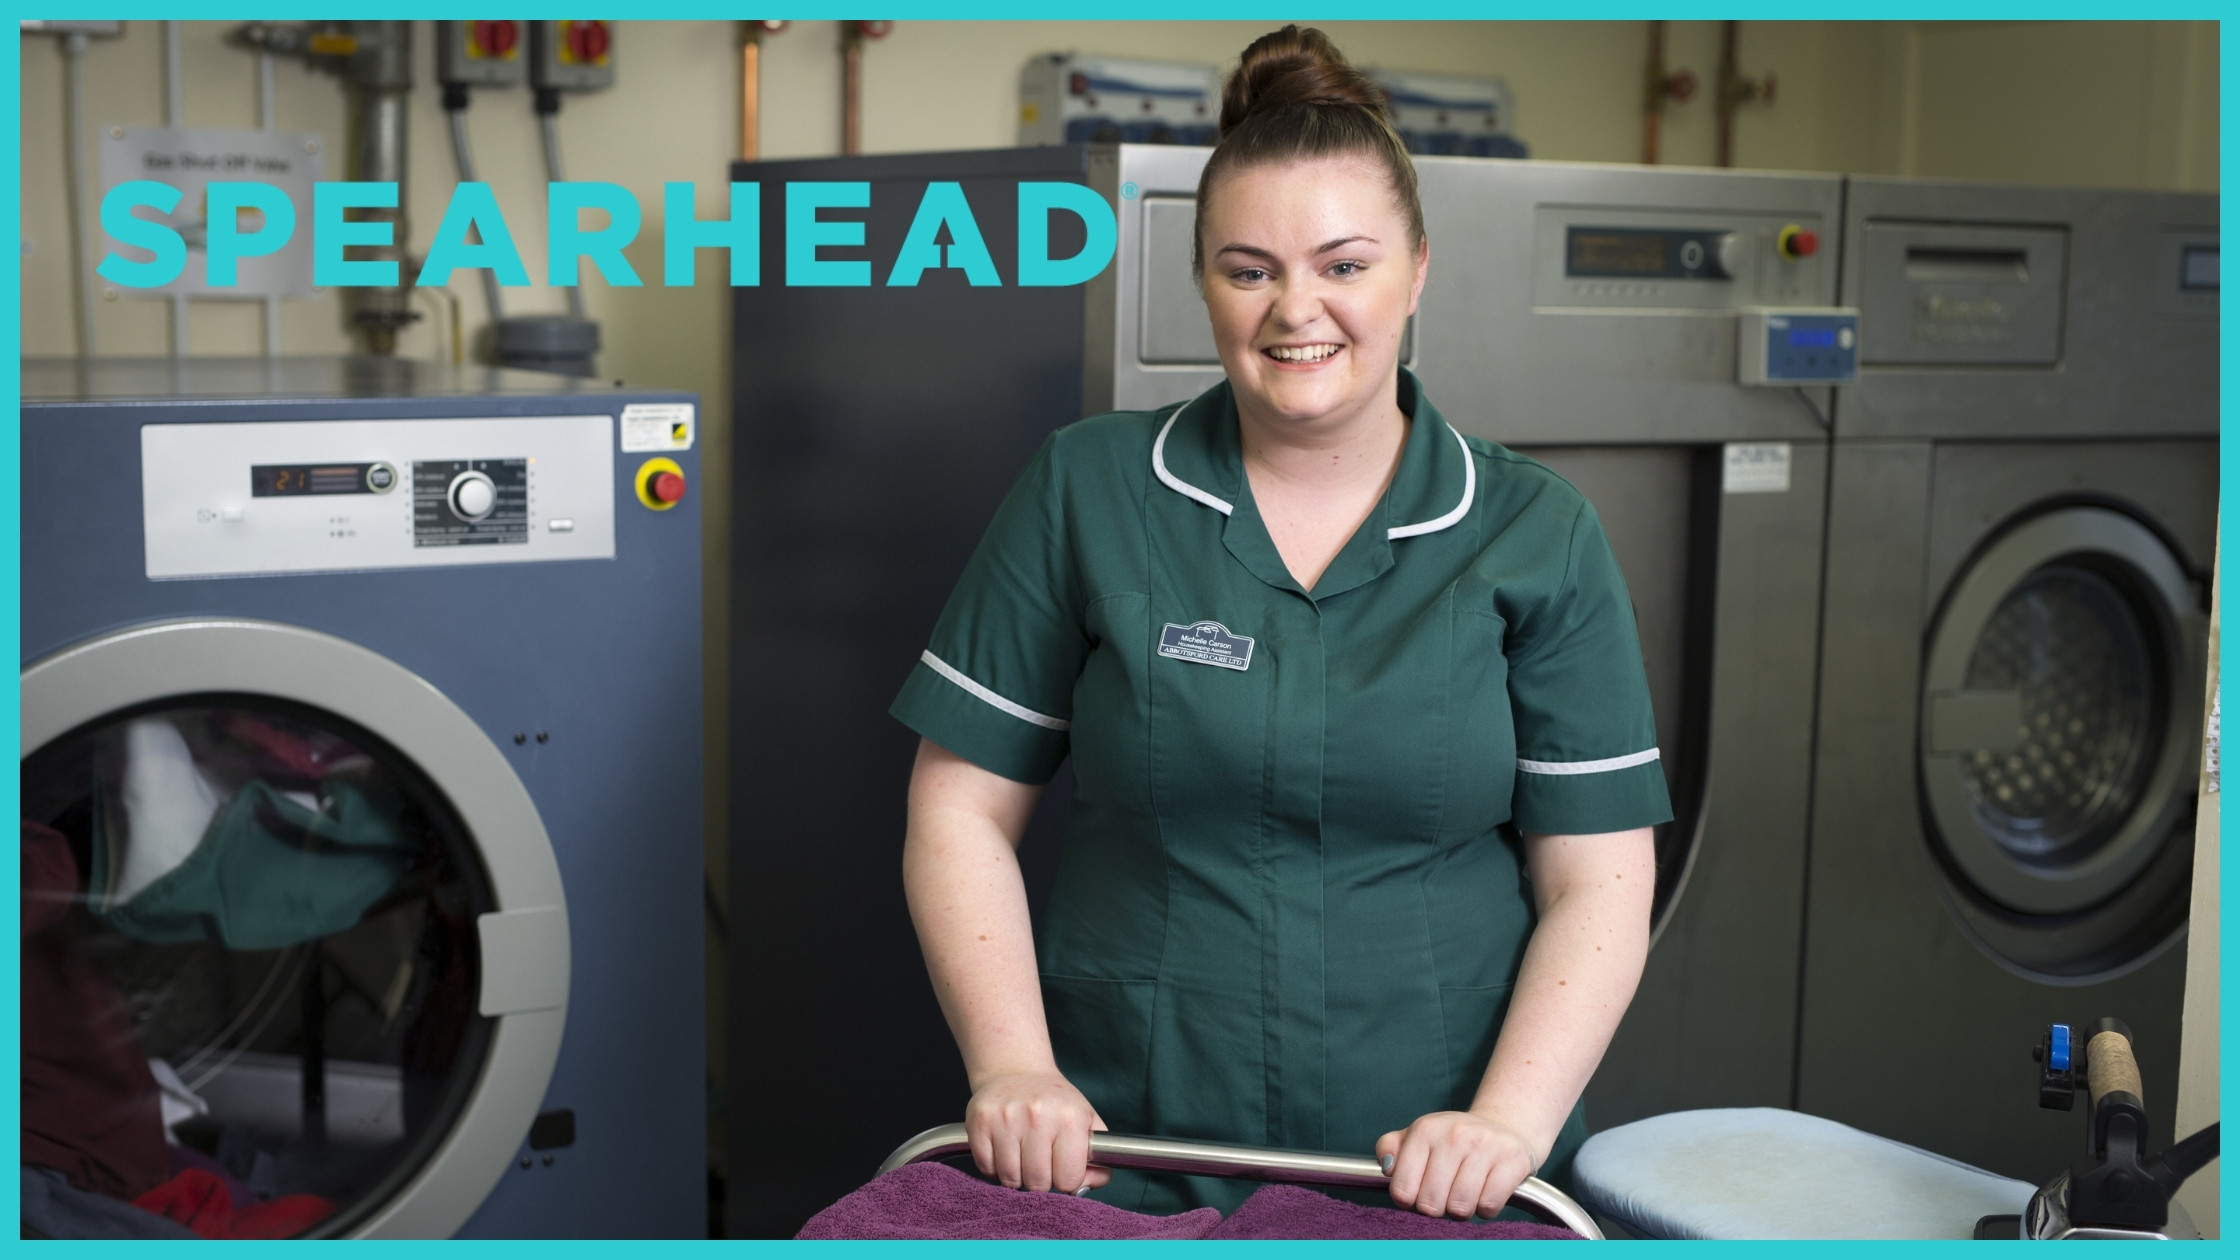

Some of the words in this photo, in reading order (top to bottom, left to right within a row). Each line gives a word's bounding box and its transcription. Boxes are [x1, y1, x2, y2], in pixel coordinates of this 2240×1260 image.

[1178, 642, 1210, 652] Housekeeping
[1181, 635, 1207, 645] Michelle
[1209, 640, 1231, 649] Carson
[1164, 647, 1208, 659] ABBOTSFORD
[1209, 655, 1227, 663] CARE
